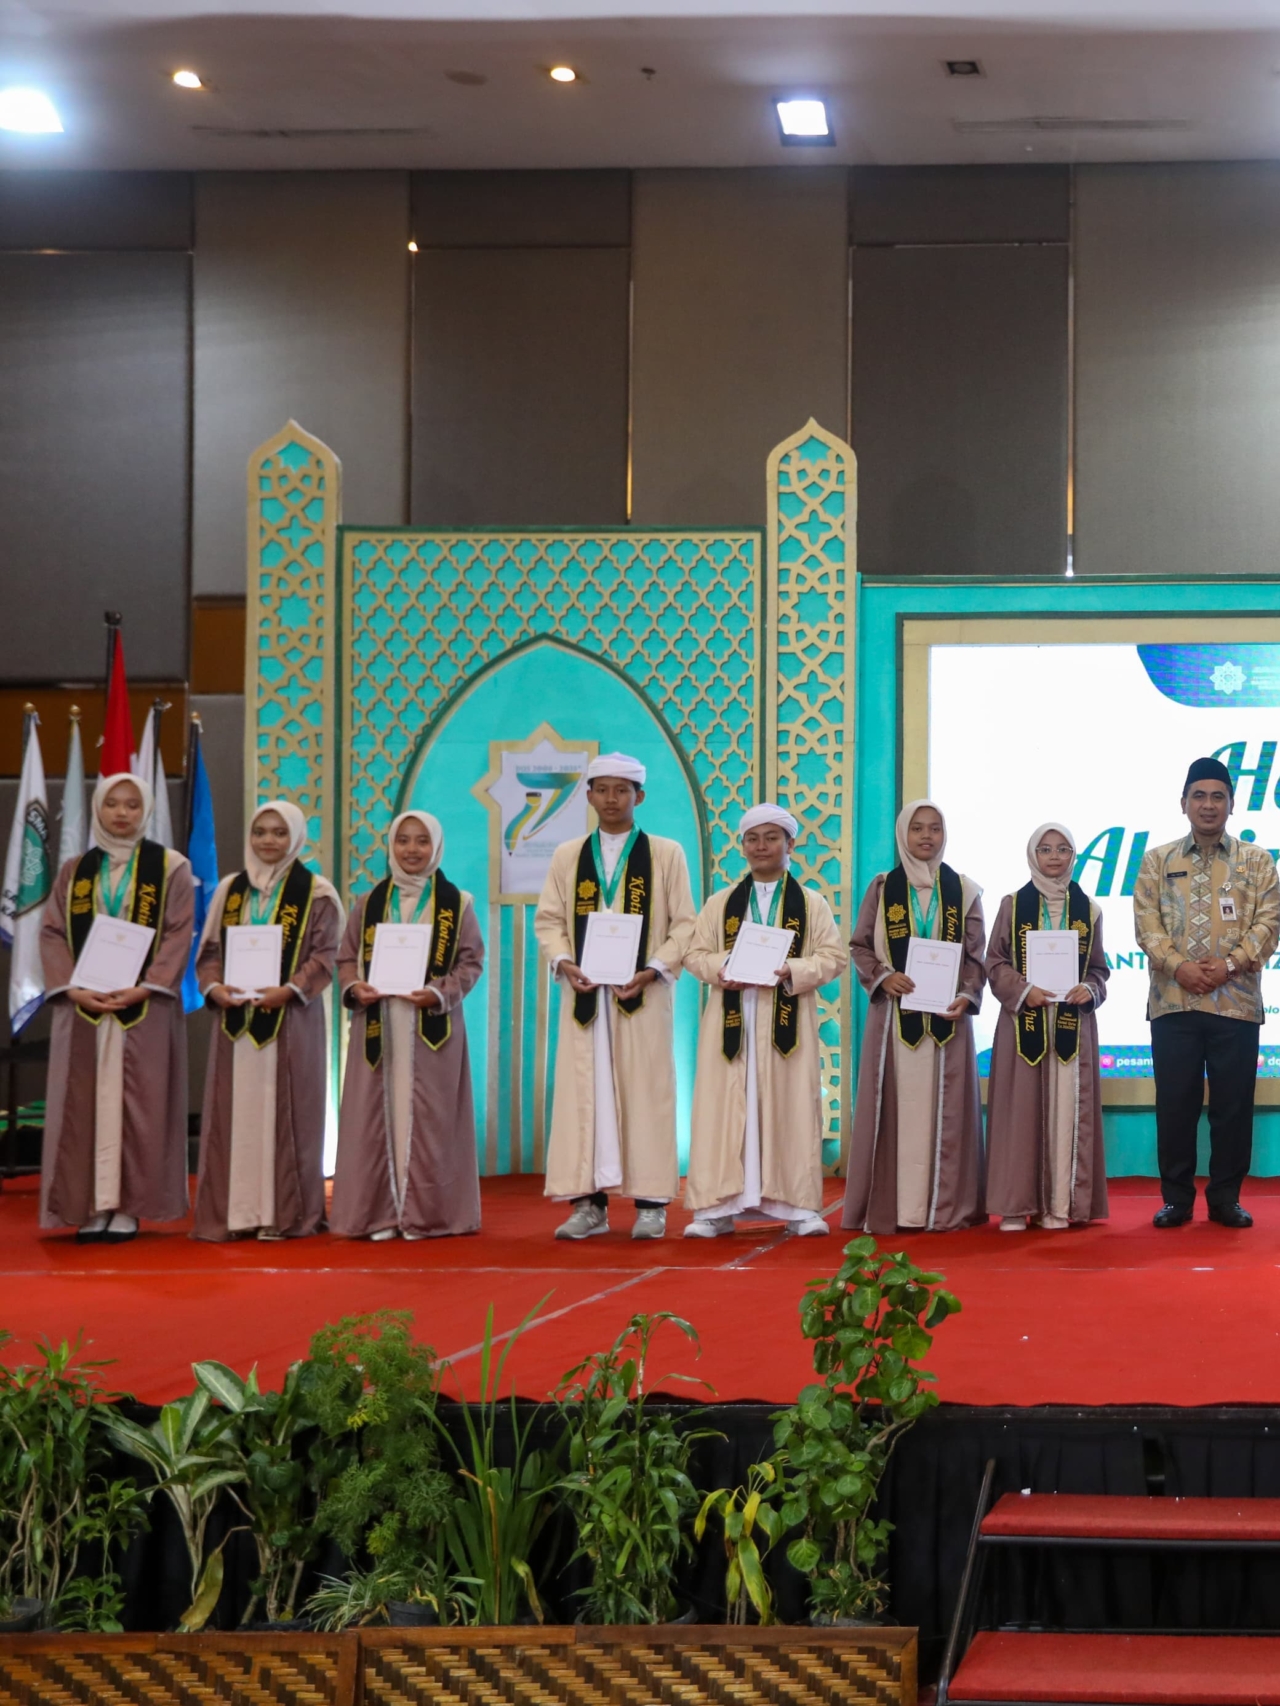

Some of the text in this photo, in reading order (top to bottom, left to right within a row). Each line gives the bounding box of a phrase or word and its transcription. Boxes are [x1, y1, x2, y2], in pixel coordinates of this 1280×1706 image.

[628, 876, 646, 916] Khoti
[945, 905, 960, 942] Khoti
[779, 1001, 792, 1027] Juz
[1023, 1009, 1037, 1032] Juz
[1116, 1056, 1153, 1067] pesant
